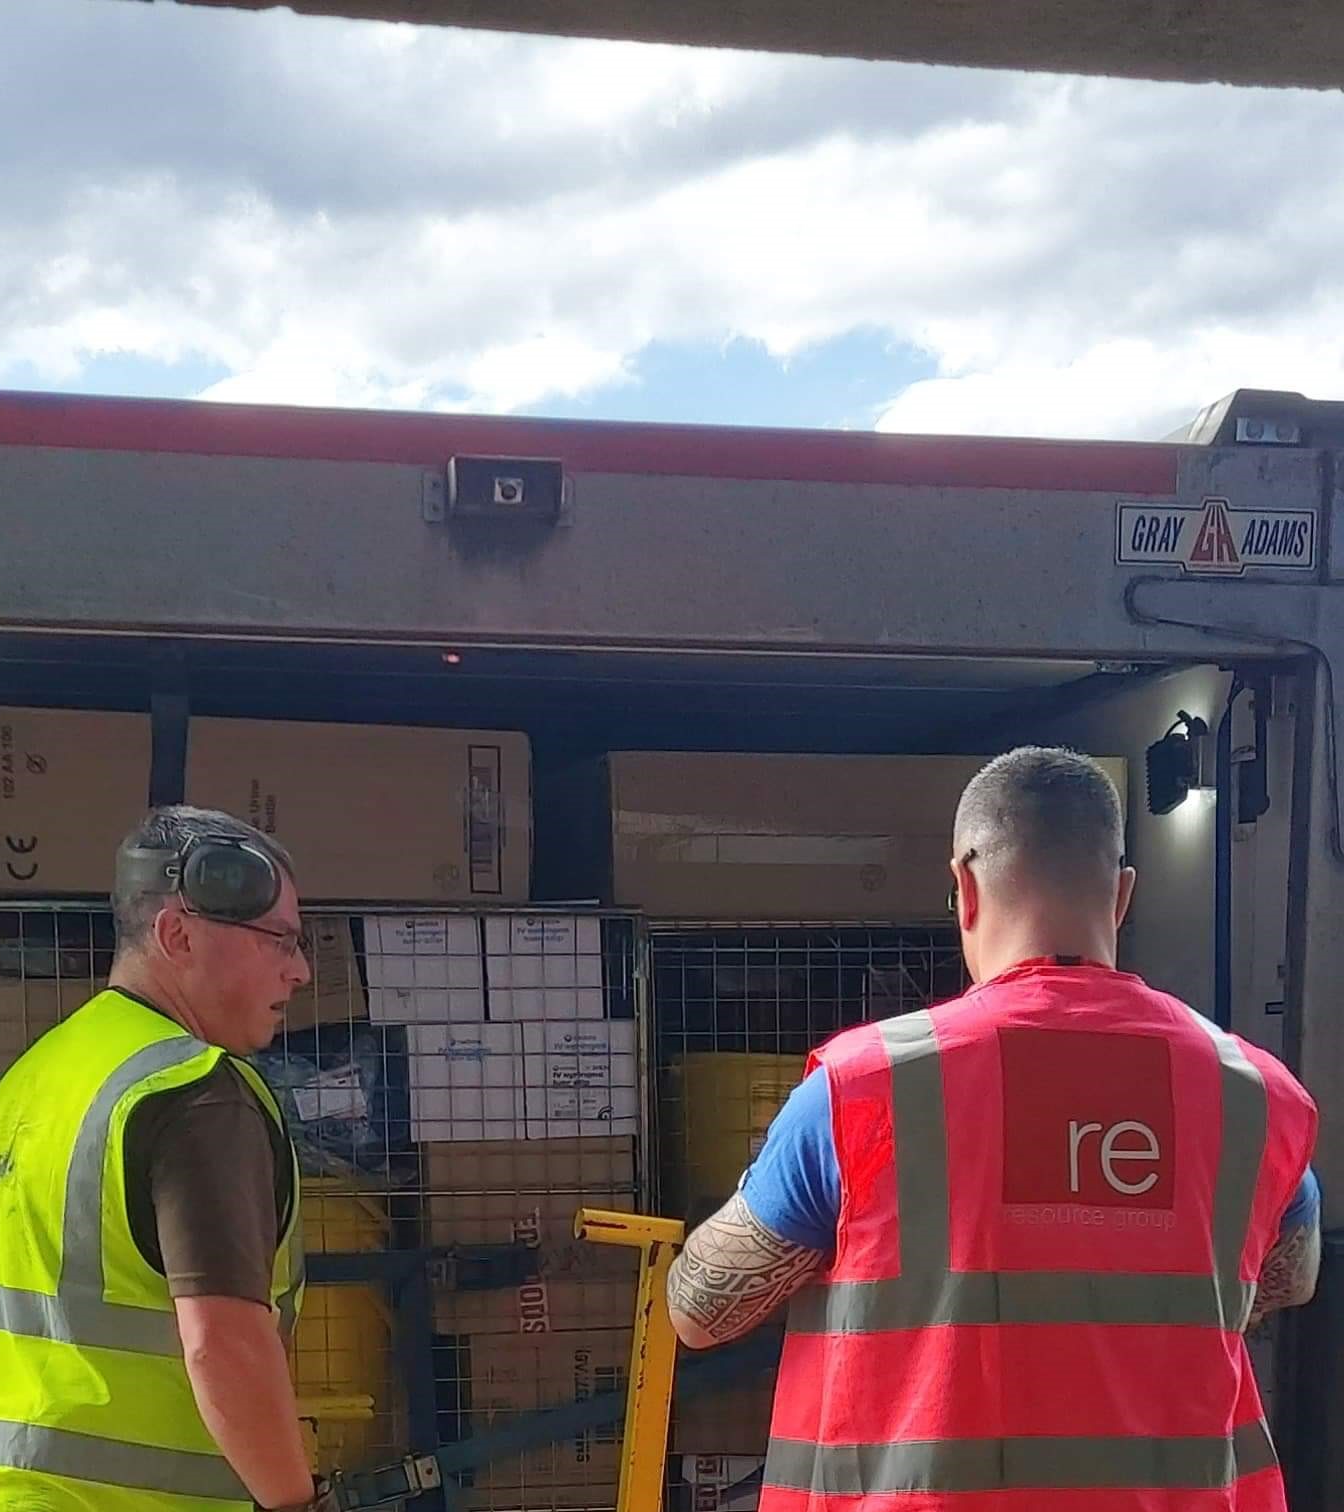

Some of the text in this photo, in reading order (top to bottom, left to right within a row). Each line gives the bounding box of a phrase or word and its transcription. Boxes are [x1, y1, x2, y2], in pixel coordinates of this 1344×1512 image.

[1131, 514, 1185, 553] GRAY
[1241, 519, 1307, 558] ADAMS
[1068, 1120, 1160, 1195] re
[1001, 1206, 1176, 1232] resource group
